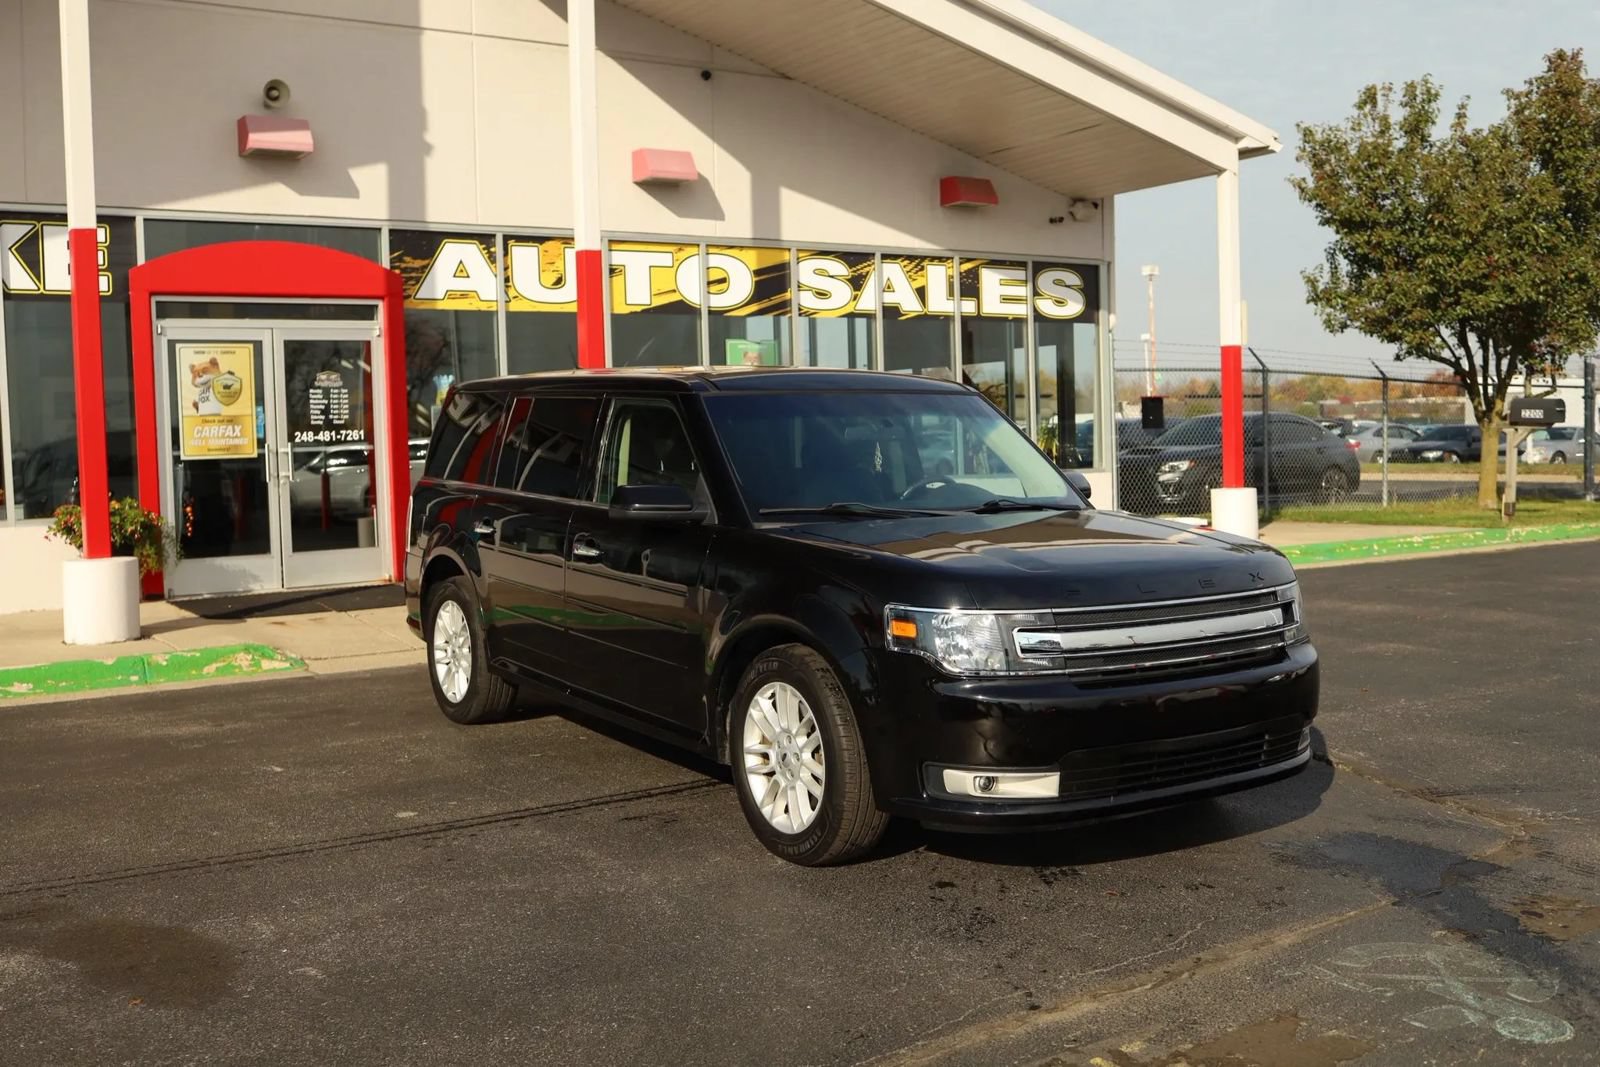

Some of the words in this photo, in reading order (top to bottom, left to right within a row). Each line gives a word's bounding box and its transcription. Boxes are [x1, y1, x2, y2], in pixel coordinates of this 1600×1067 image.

[413, 239, 755, 311] AUTO
[796, 256, 1087, 320] SALES
[1521, 409, 1544, 418] 2200
[193, 425, 242, 438] CARFAX
[294, 429, 365, 443] 248-481-7261
